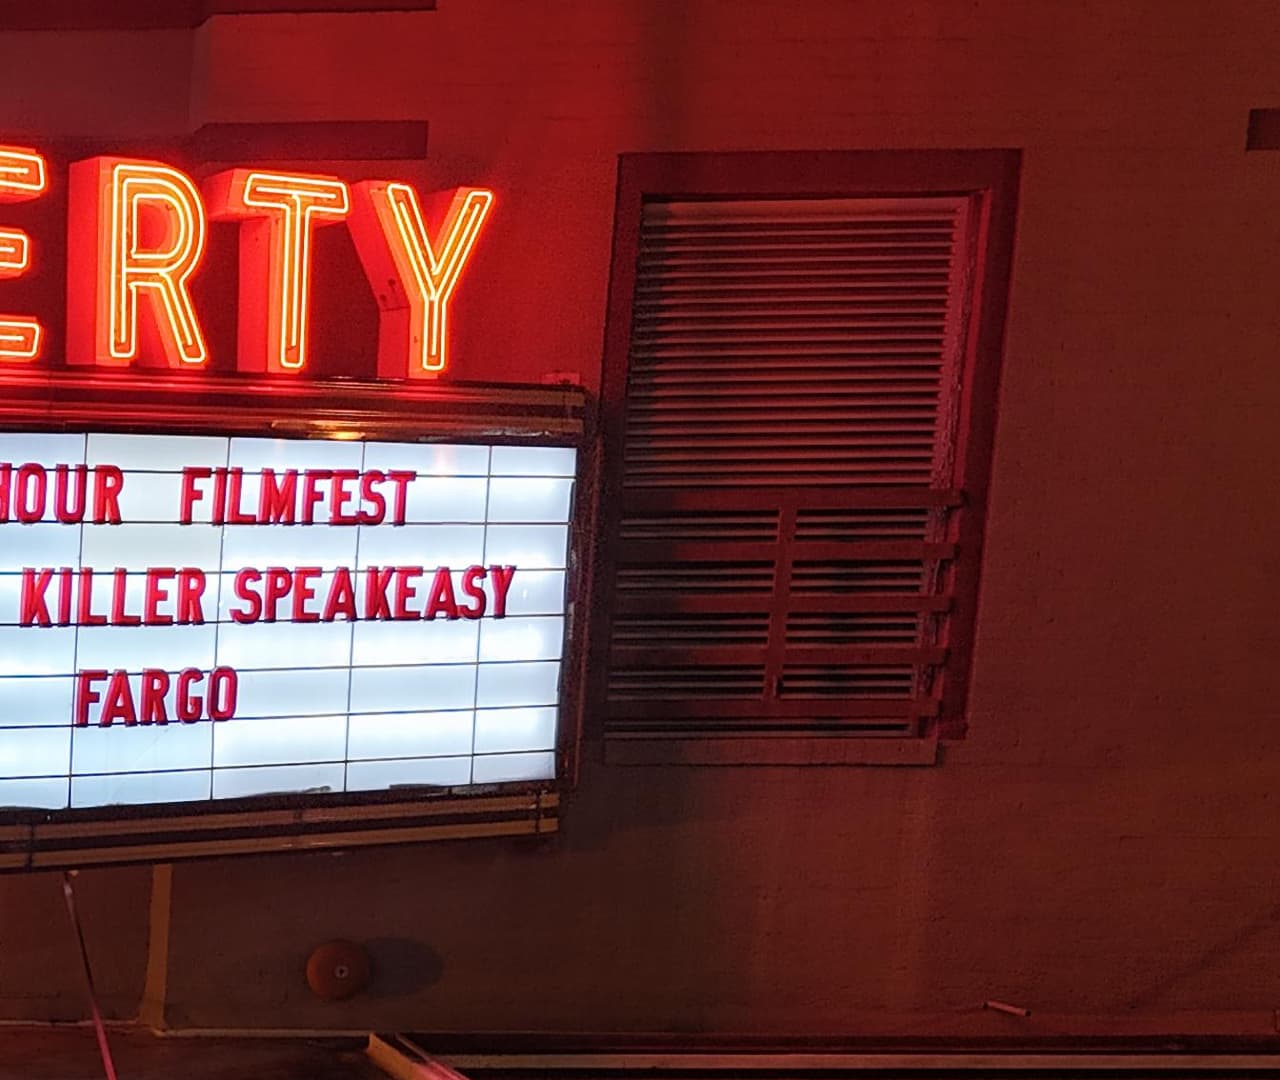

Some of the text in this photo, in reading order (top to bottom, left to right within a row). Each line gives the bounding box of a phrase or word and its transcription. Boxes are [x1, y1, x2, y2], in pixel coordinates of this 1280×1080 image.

[179, 467, 416, 528] FILMFEST
[18, 567, 208, 628] KILLER
[228, 564, 517, 626] SPEAKEASY
[73, 665, 239, 728] FARGO
